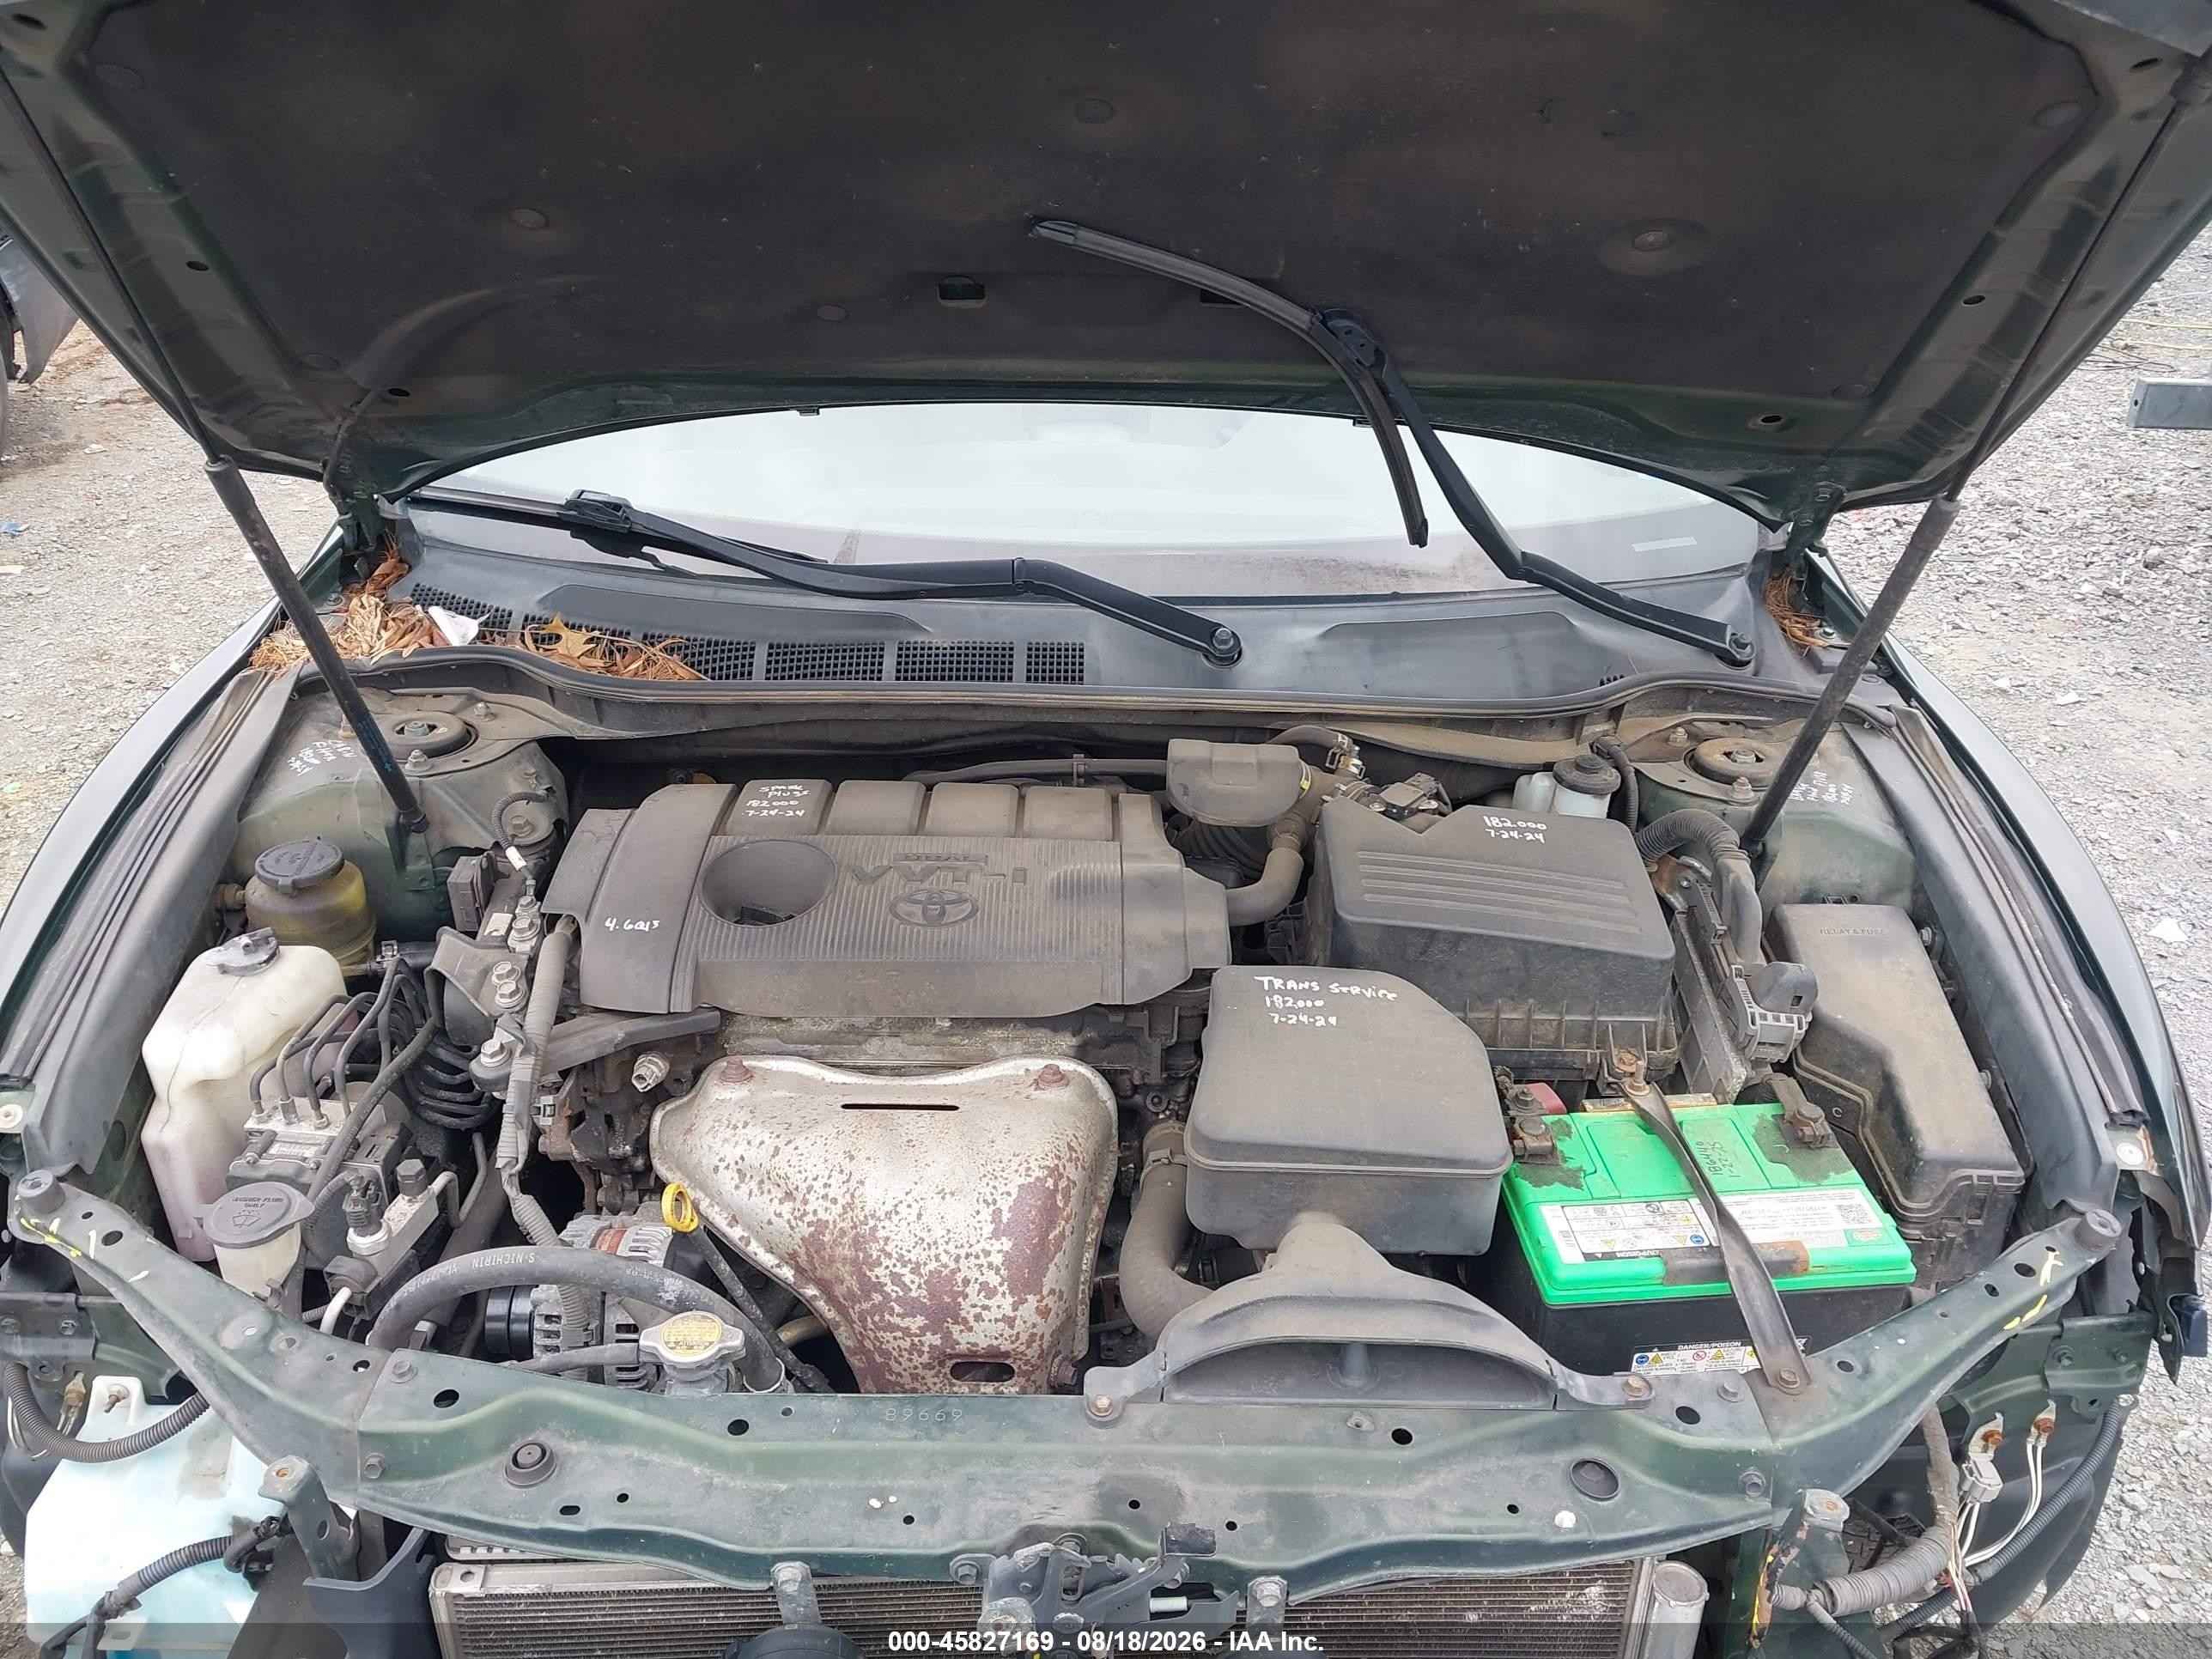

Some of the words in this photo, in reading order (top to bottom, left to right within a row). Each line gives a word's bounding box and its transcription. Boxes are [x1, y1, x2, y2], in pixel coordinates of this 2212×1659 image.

[1486, 829, 1546, 843] 7-24-24
[1254, 976, 1320, 991] TRANS
[1269, 1012, 1337, 1027] 7-24-24
[1678, 1341, 1742, 1351] DANGER/POISON
[885, 1408, 963, 1421] 89669
